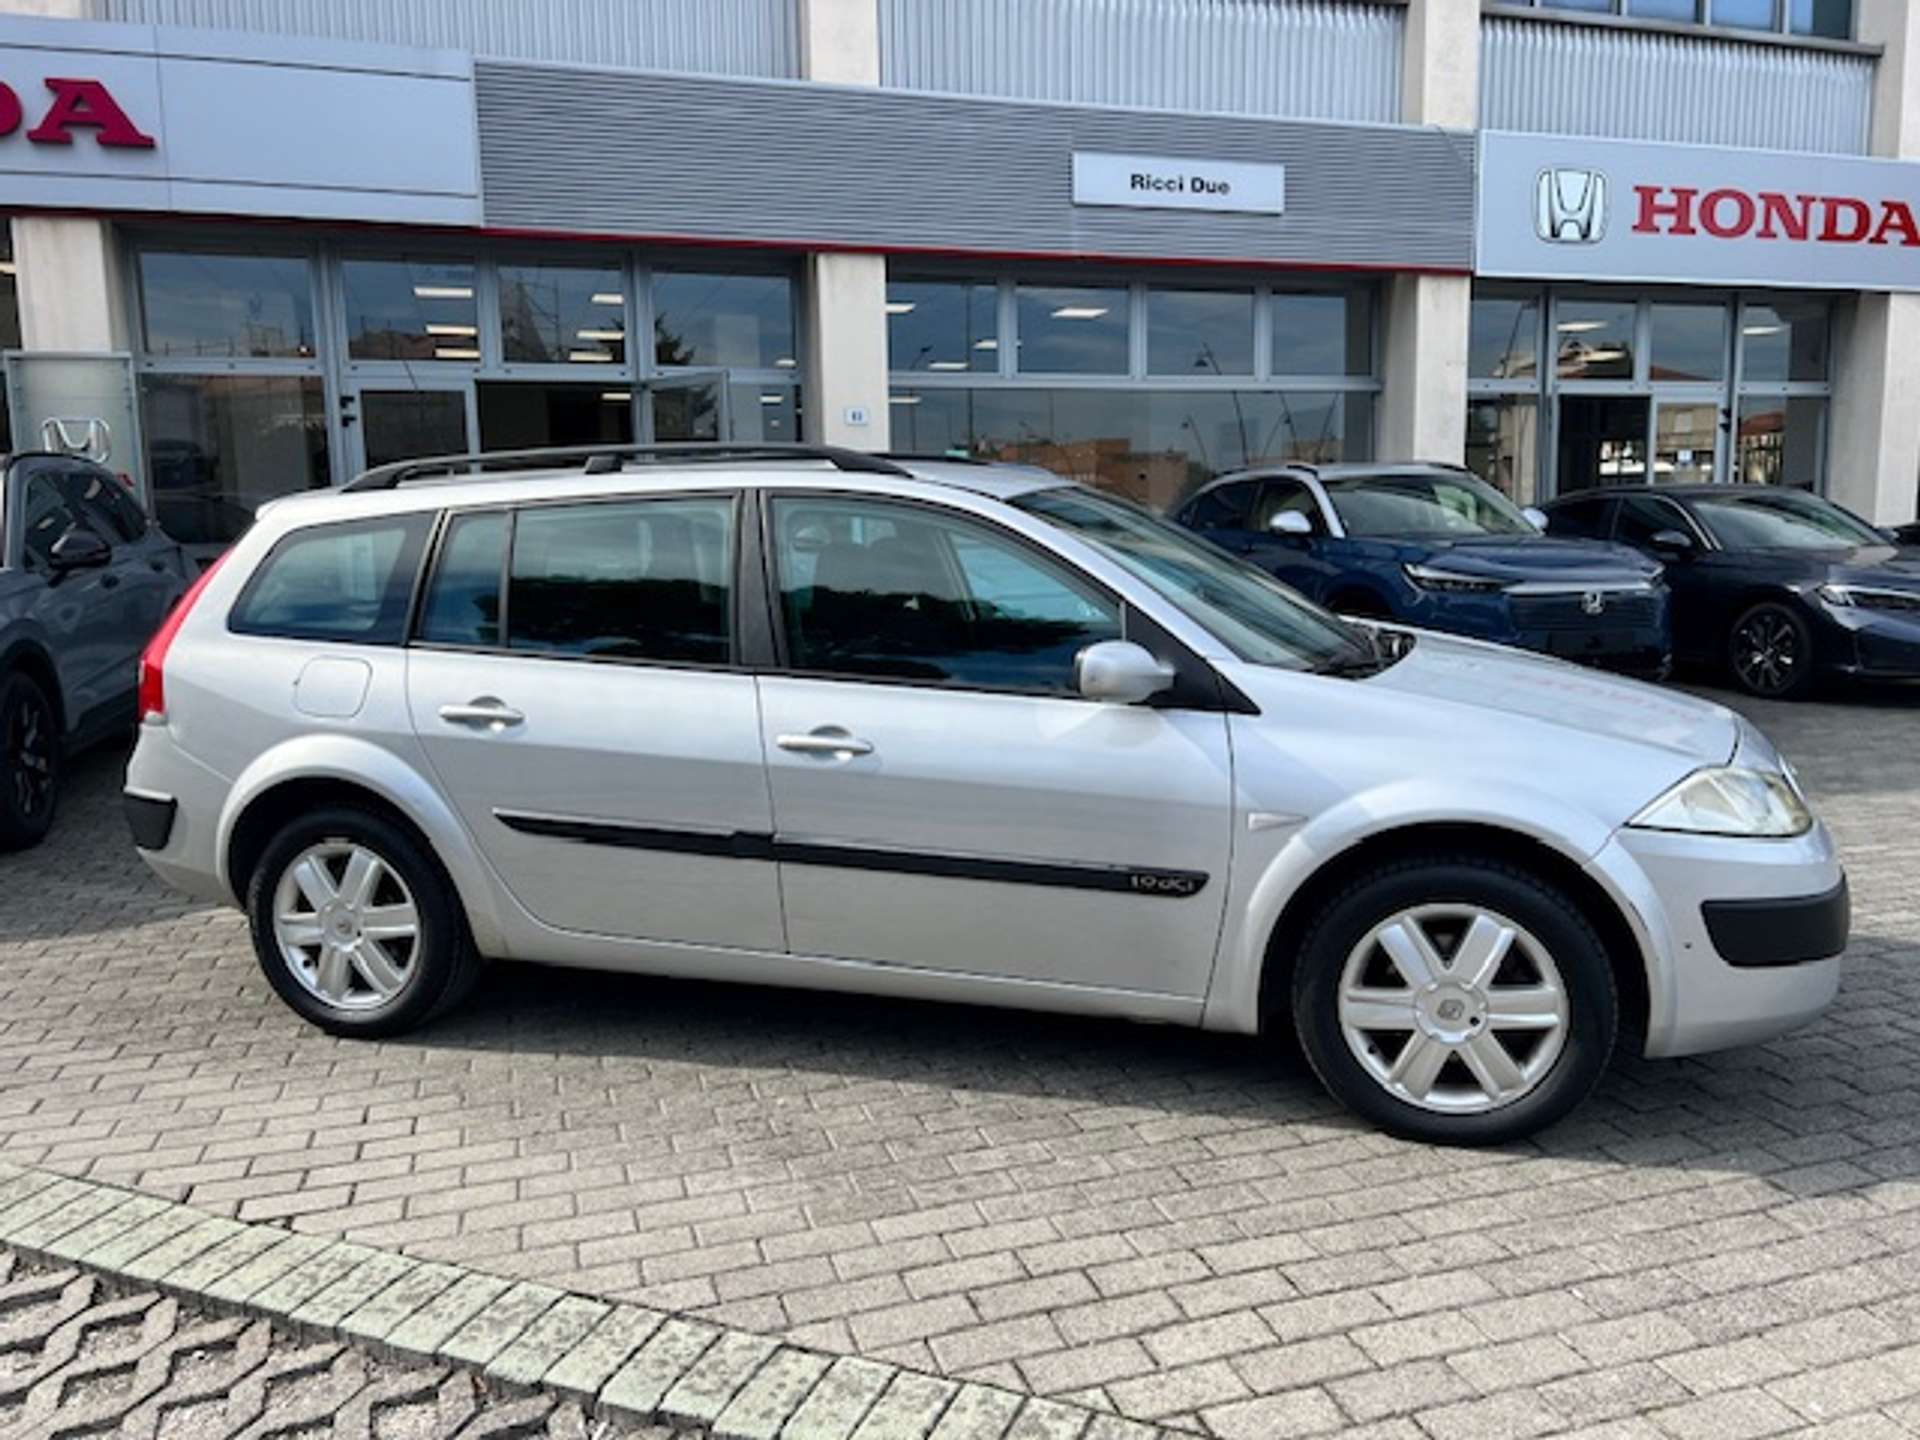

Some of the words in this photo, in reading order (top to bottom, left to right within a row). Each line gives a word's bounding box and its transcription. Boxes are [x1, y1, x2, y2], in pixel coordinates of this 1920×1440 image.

[1130, 173, 1184, 192] Ricci
[1191, 176, 1231, 195] Due
[1632, 185, 1920, 247] HONDA
